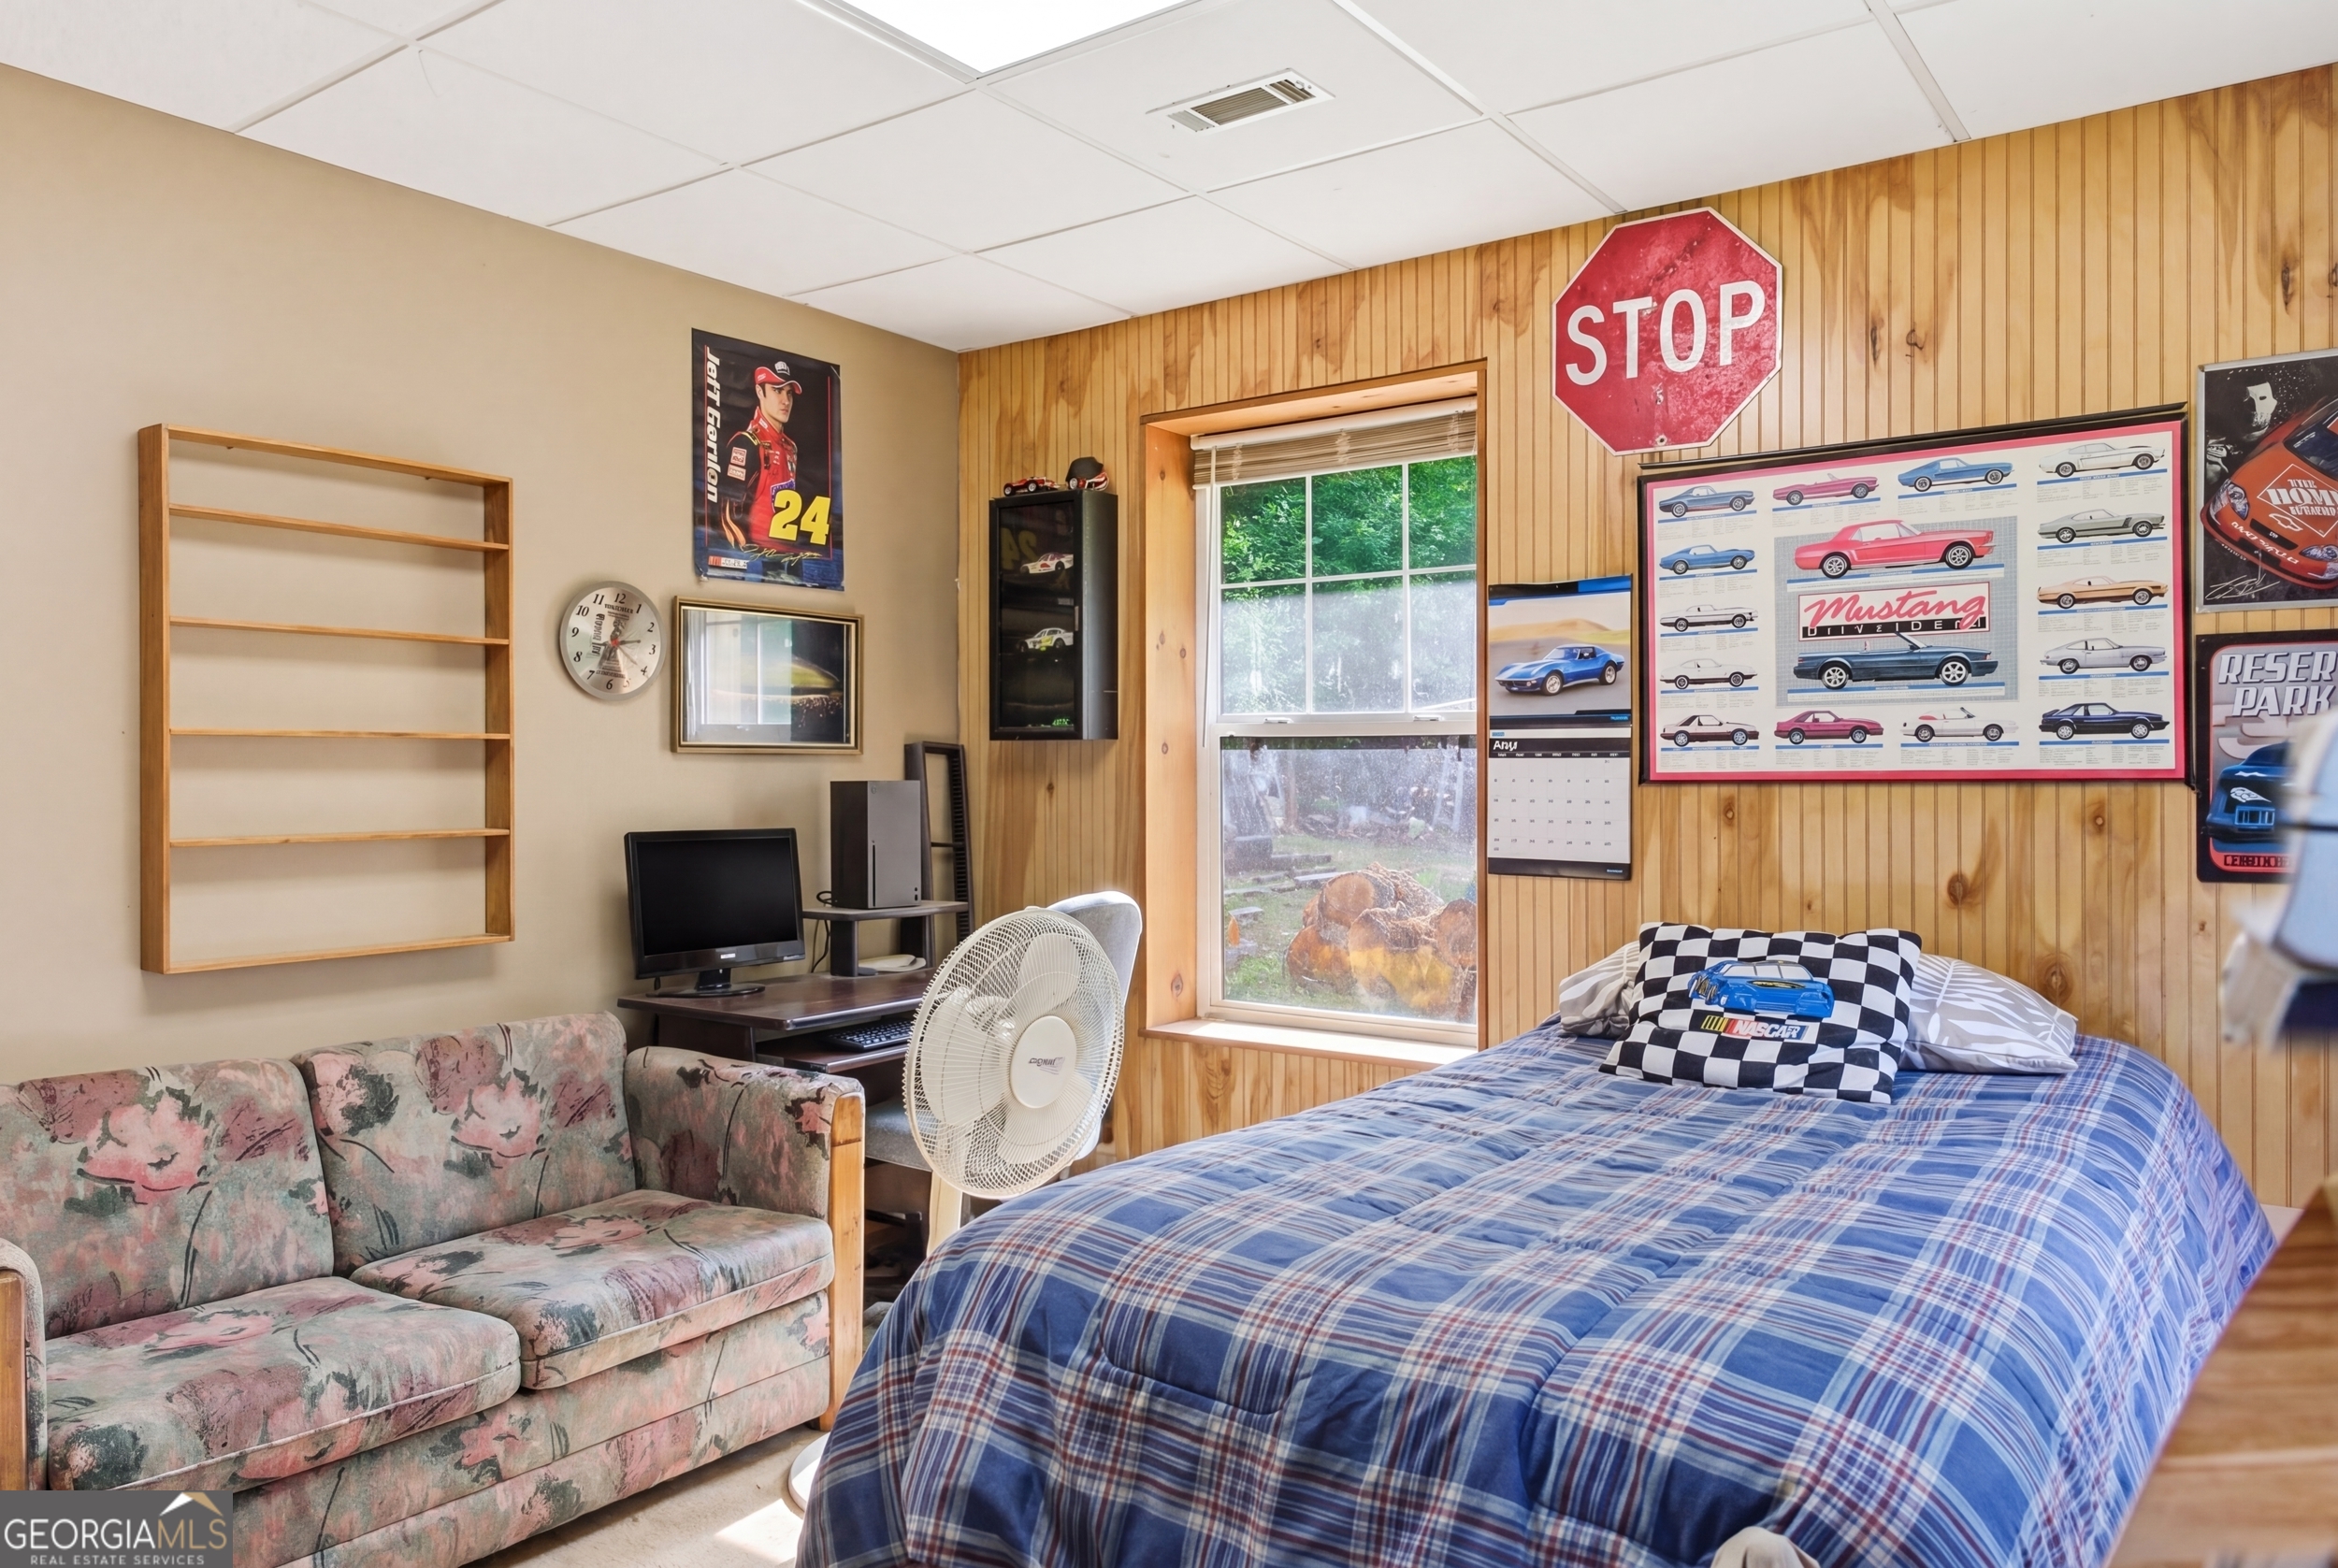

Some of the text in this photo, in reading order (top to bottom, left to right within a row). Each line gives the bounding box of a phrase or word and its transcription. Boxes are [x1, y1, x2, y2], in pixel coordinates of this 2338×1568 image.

[1566, 280, 1766, 386] STOP
[768, 489, 831, 546] 24
[593, 593, 605, 605] 11
[614, 593, 627, 604] 12
[575, 605, 590, 617] 10
[635, 603, 642, 614] 1
[1804, 590, 1985, 630] Mustang
[571, 626, 579, 638] 9
[646, 622, 655, 633] 2
[648, 644, 657, 655] 3
[573, 651, 583, 663] 8
[586, 669, 595, 680] 7
[640, 665, 648, 676] 4
[606, 678, 613, 690] 6
[2231, 684, 2335, 718] PARK
[1733, 1020, 1801, 1039] NASCAR
